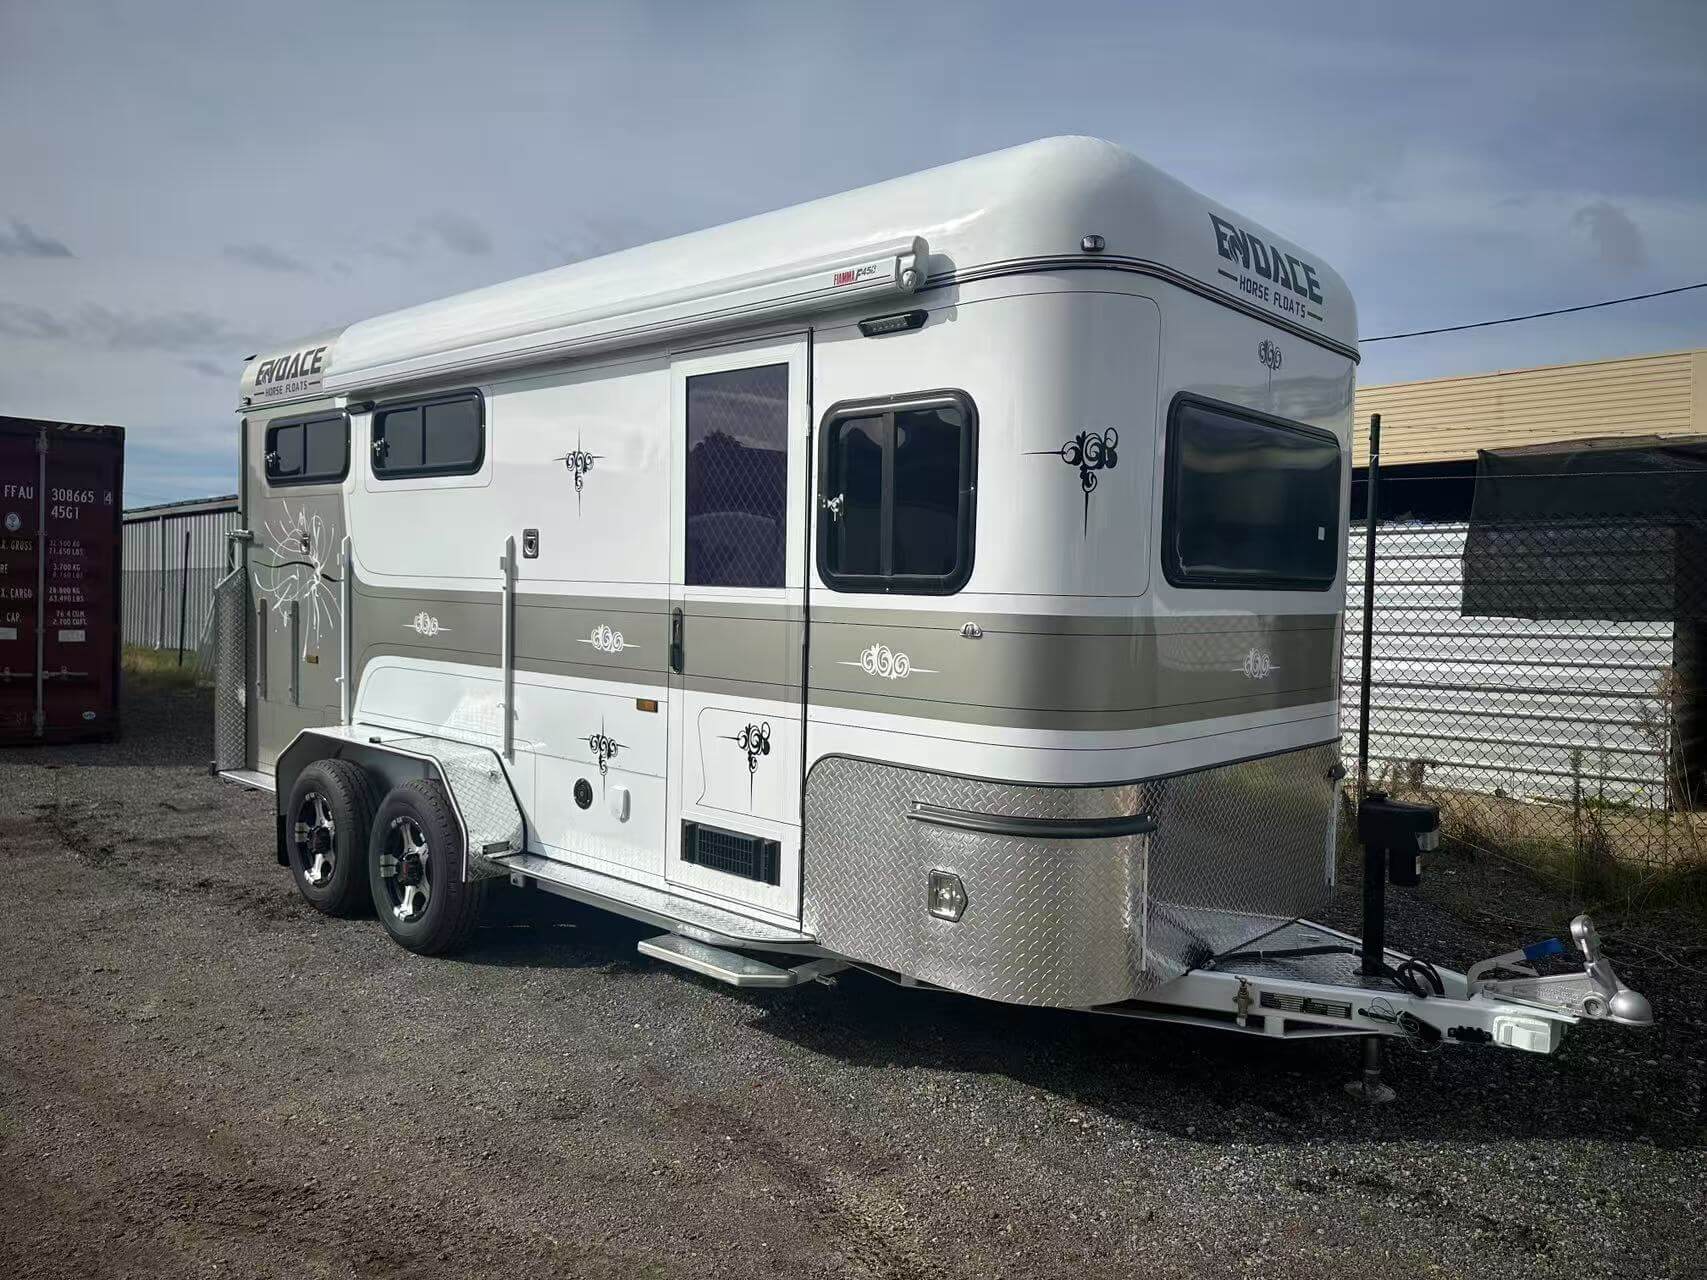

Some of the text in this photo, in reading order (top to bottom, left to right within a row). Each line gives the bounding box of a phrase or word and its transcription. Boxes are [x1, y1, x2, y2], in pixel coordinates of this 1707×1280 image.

[1208, 212, 1323, 305] ENDACE
[1239, 275, 1306, 319] HORSE FLOATS
[255, 346, 327, 386] ENDACE
[265, 380, 308, 397] HORSE FLOATS
[4, 484, 34, 499] FFAU
[51, 488, 95, 503] 308665
[51, 505, 79, 520] 45G1
